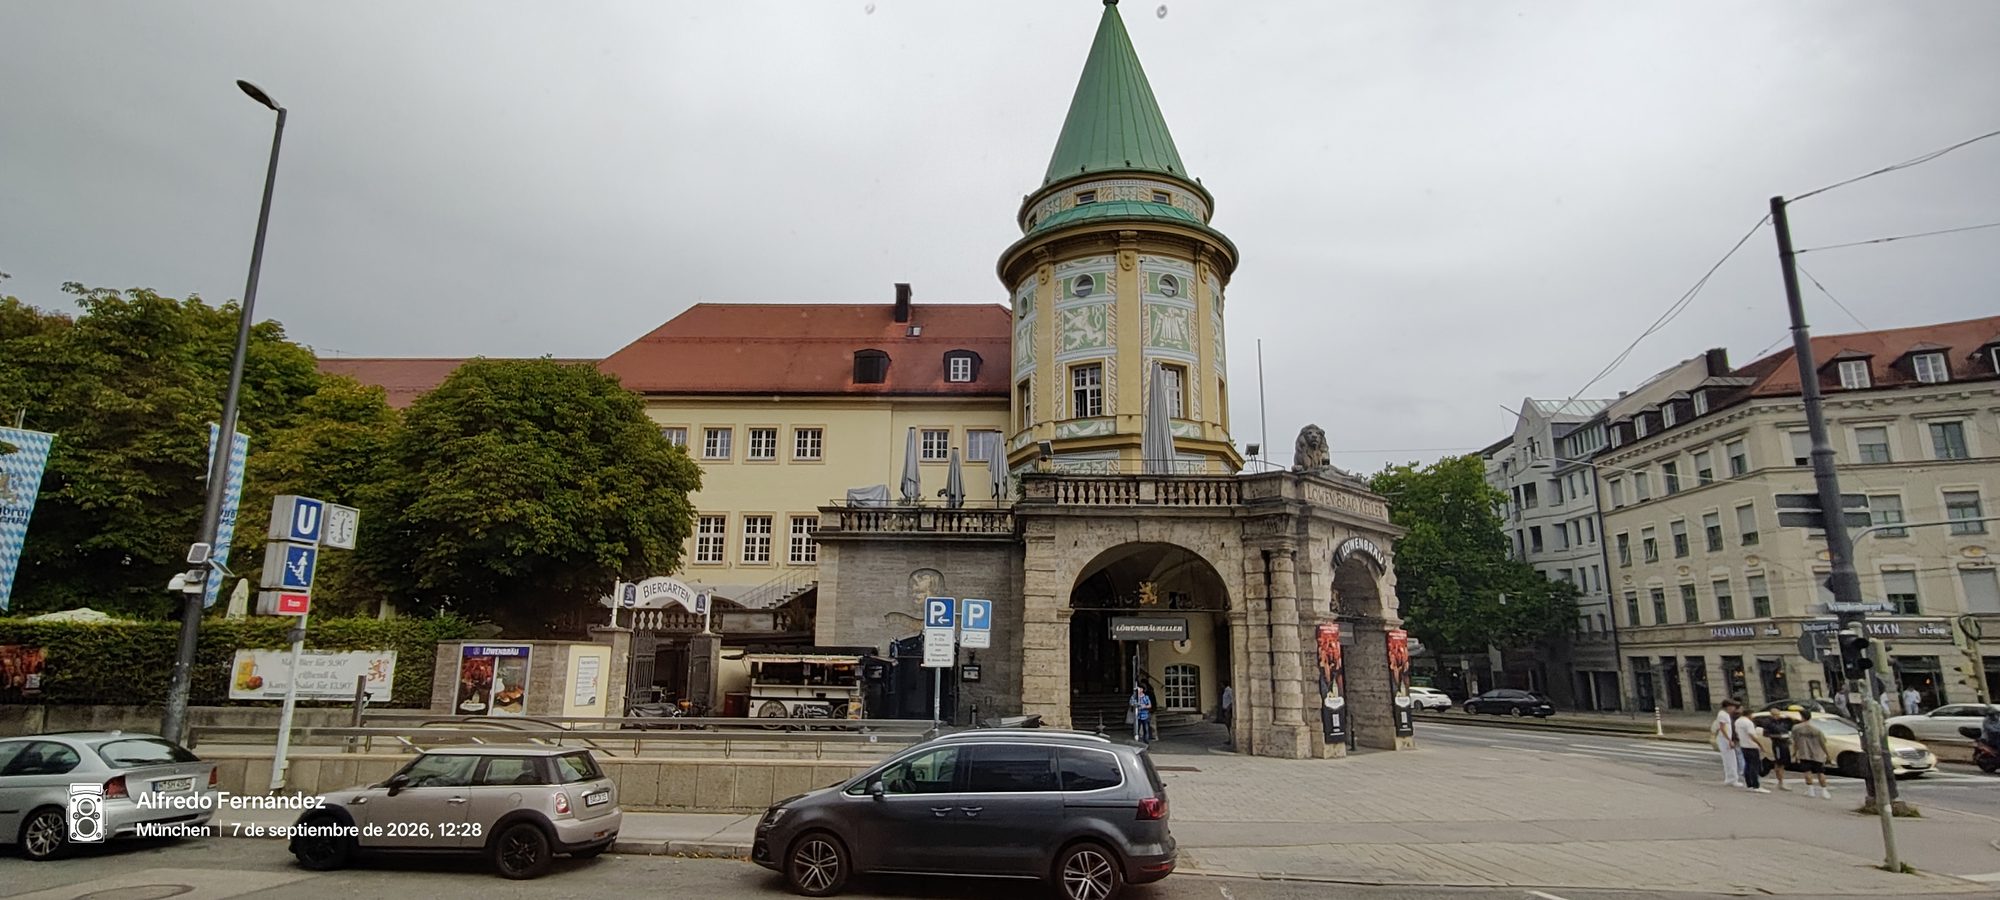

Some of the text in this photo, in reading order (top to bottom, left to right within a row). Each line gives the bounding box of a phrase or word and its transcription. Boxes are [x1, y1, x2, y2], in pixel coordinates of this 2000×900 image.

[297, 504, 317, 534] U
[643, 582, 691, 602] BIERGARTEN
[930, 602, 946, 624] P
[969, 604, 984, 626] P
[482, 647, 520, 656] LÖWENBRÄU
